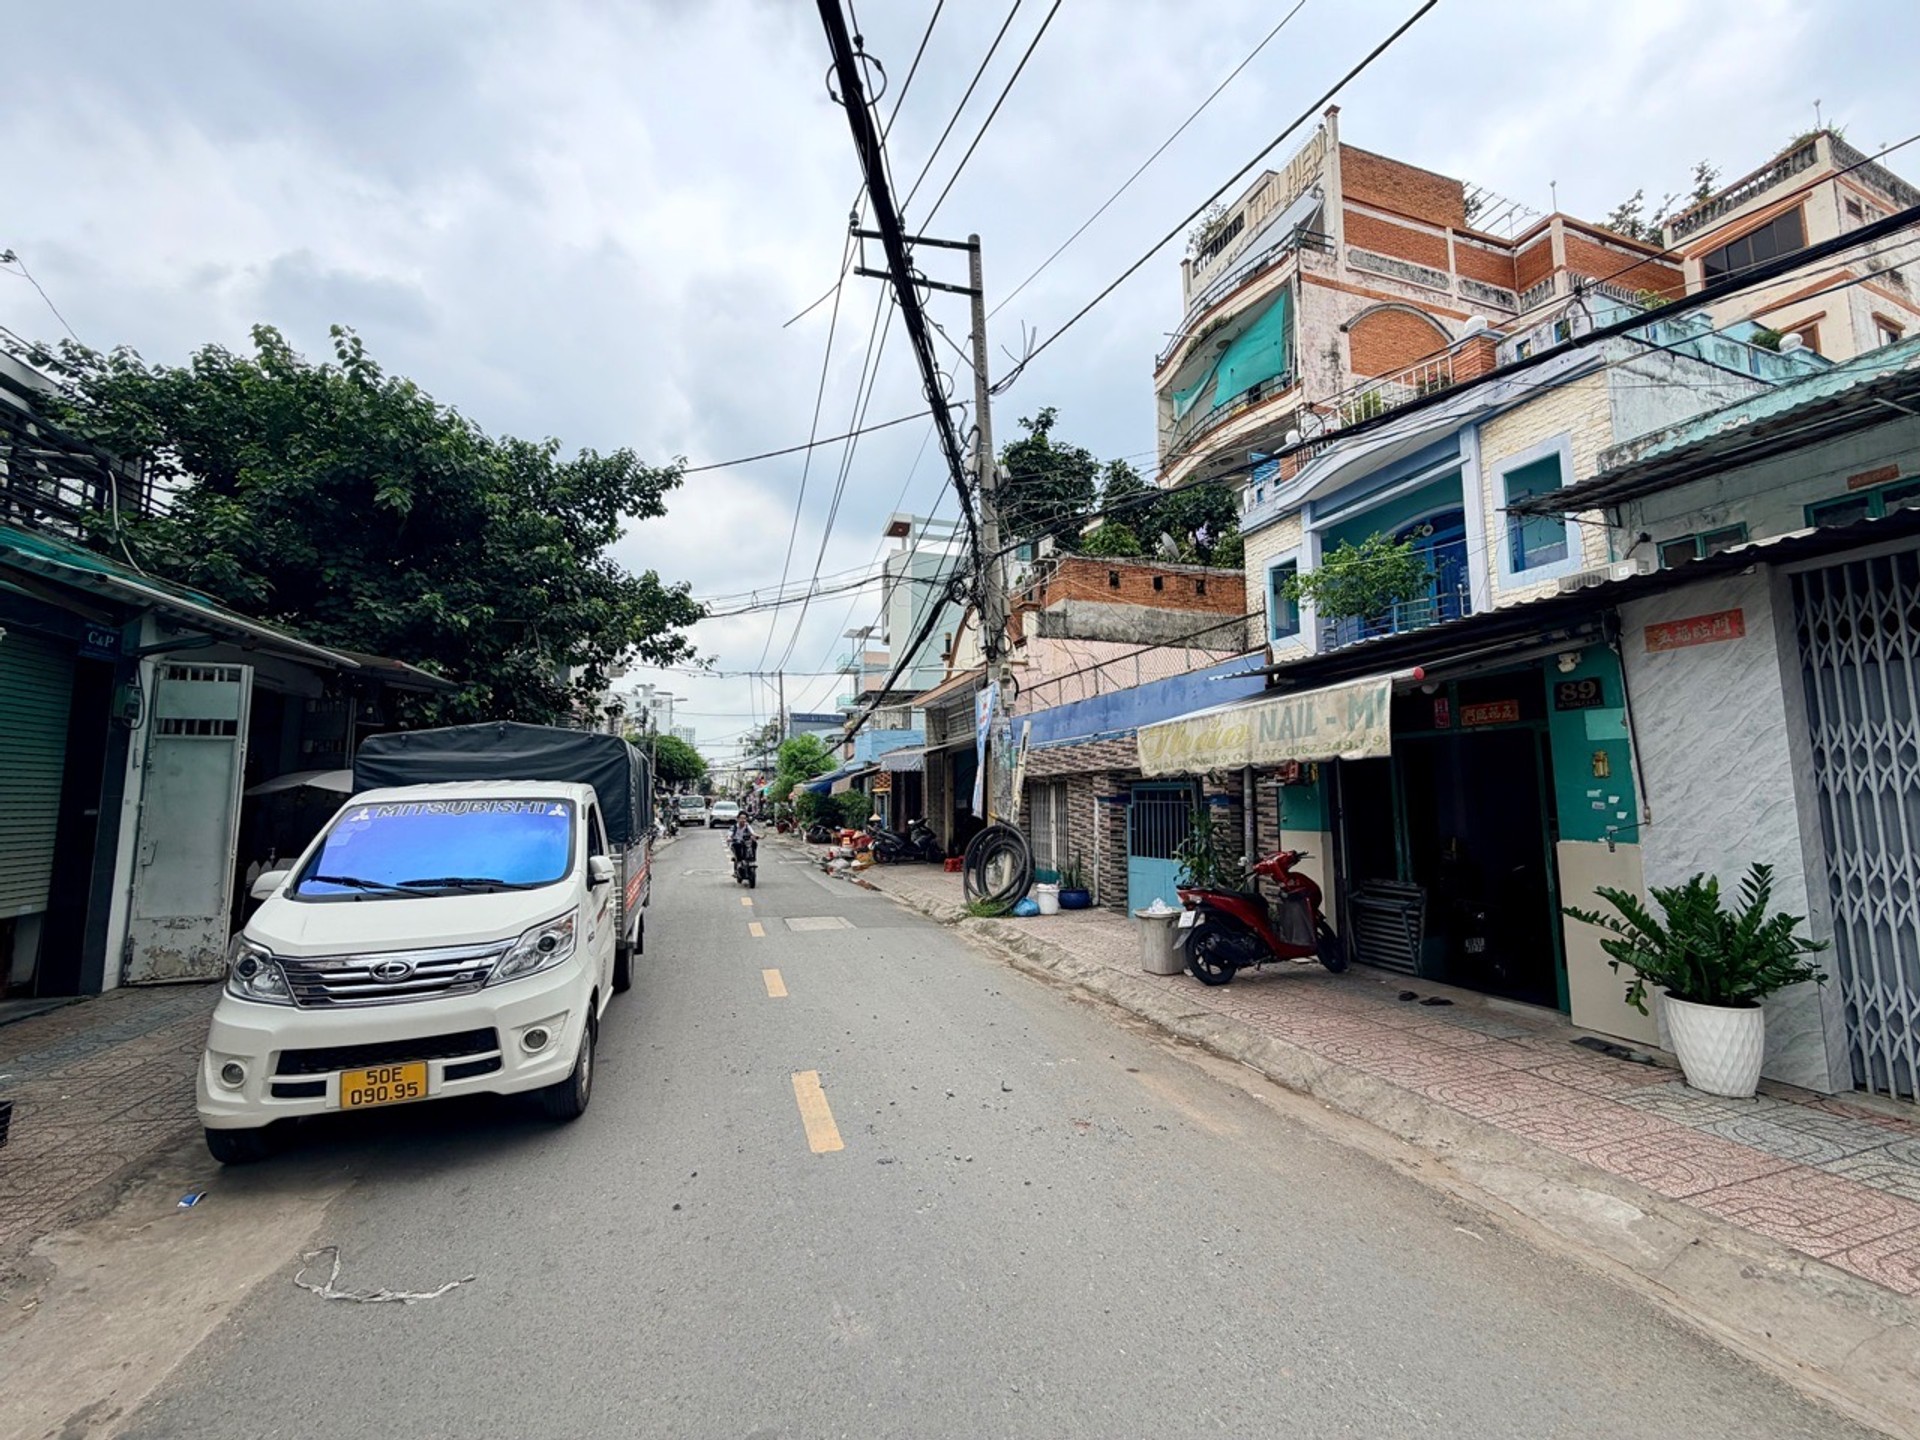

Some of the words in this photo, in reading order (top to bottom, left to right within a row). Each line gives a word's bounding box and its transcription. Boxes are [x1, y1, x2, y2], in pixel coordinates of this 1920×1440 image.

[1560, 680, 1597, 702] 89
[1258, 702, 1318, 743] NAIL
[375, 800, 547, 818] MITSUBISHI
[366, 1067, 402, 1086] 50E
[351, 1082, 418, 1105] 090.95
